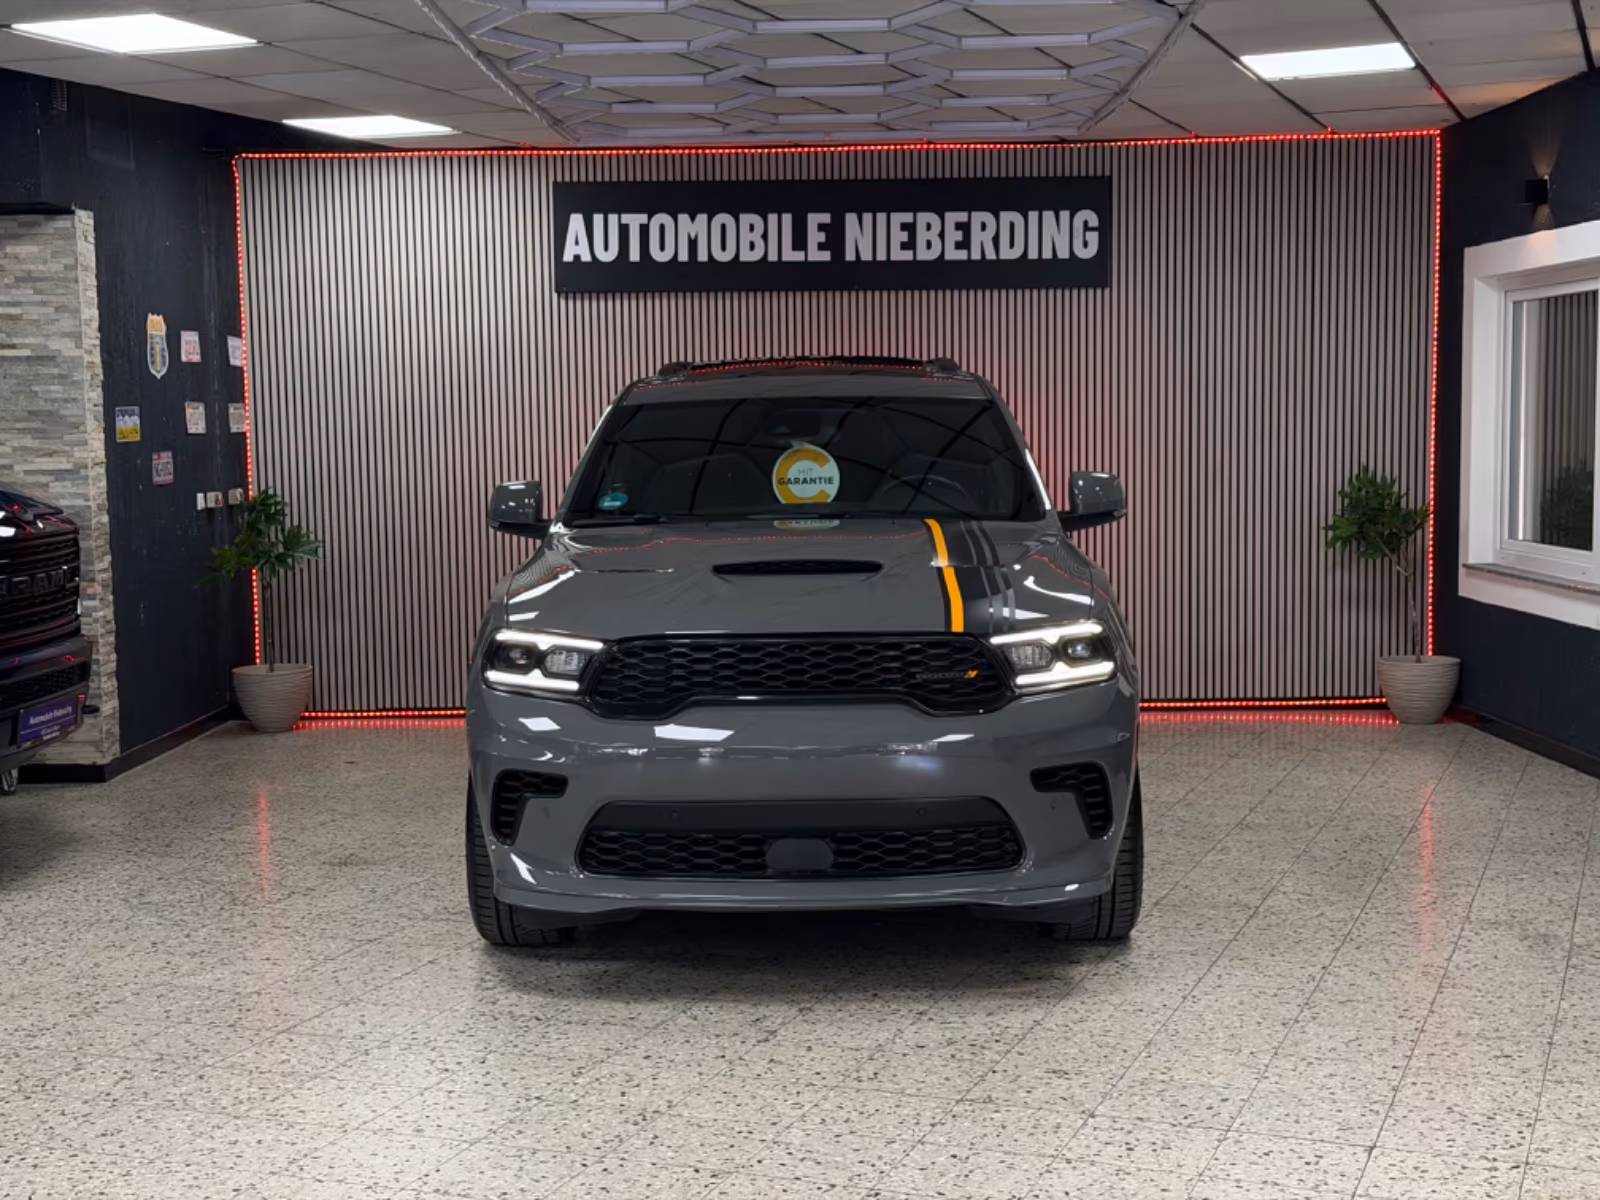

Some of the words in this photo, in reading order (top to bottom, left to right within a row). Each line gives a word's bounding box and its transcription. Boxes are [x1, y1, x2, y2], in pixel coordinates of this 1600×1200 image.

[563, 212, 831, 263] AUTOMOBILE
[845, 209, 1100, 261] NIEBERDING
[797, 468, 814, 476] MIT
[777, 476, 834, 486] GARANTIE
